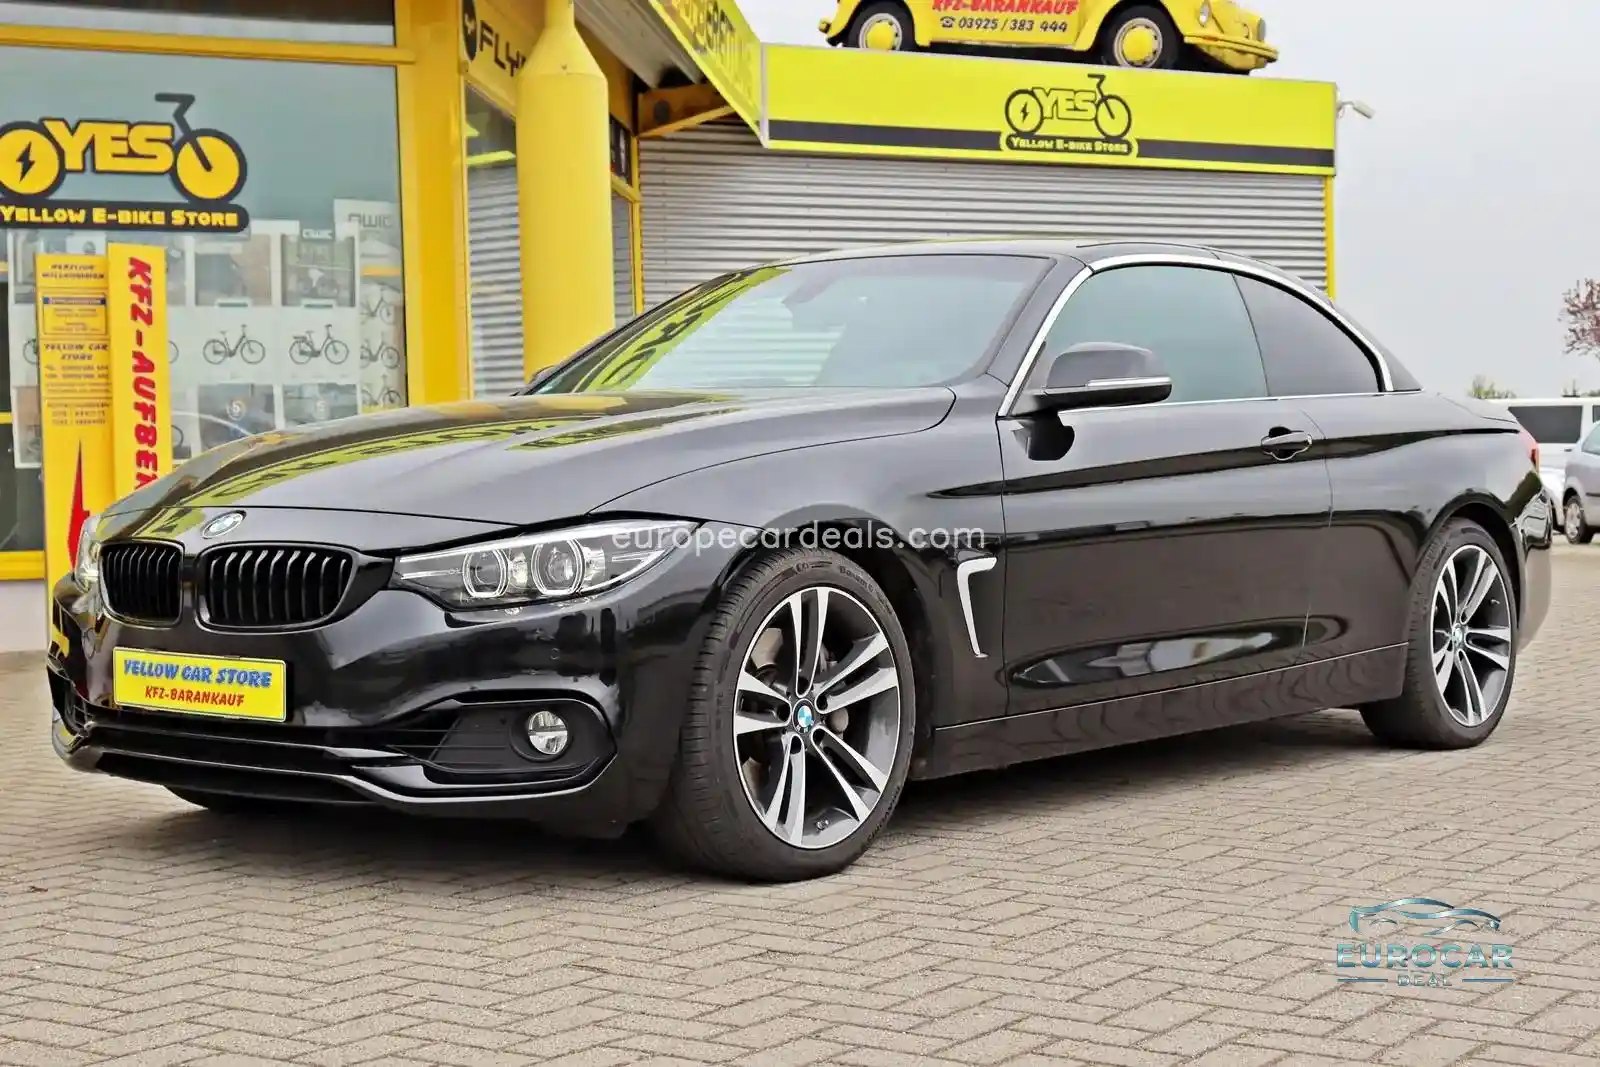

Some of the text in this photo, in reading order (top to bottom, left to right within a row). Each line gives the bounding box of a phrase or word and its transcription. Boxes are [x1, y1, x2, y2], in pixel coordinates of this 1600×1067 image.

[958, 16, 999, 30] 03925
[1010, 18, 1035, 31] 383
[1039, 20, 1068, 33] 444
[1032, 86, 1097, 121] YES
[41, 117, 175, 174] YES
[123, 659, 273, 688] YELLOW CAR STORE
[144, 685, 245, 707] KFZ-BARANKAUF
